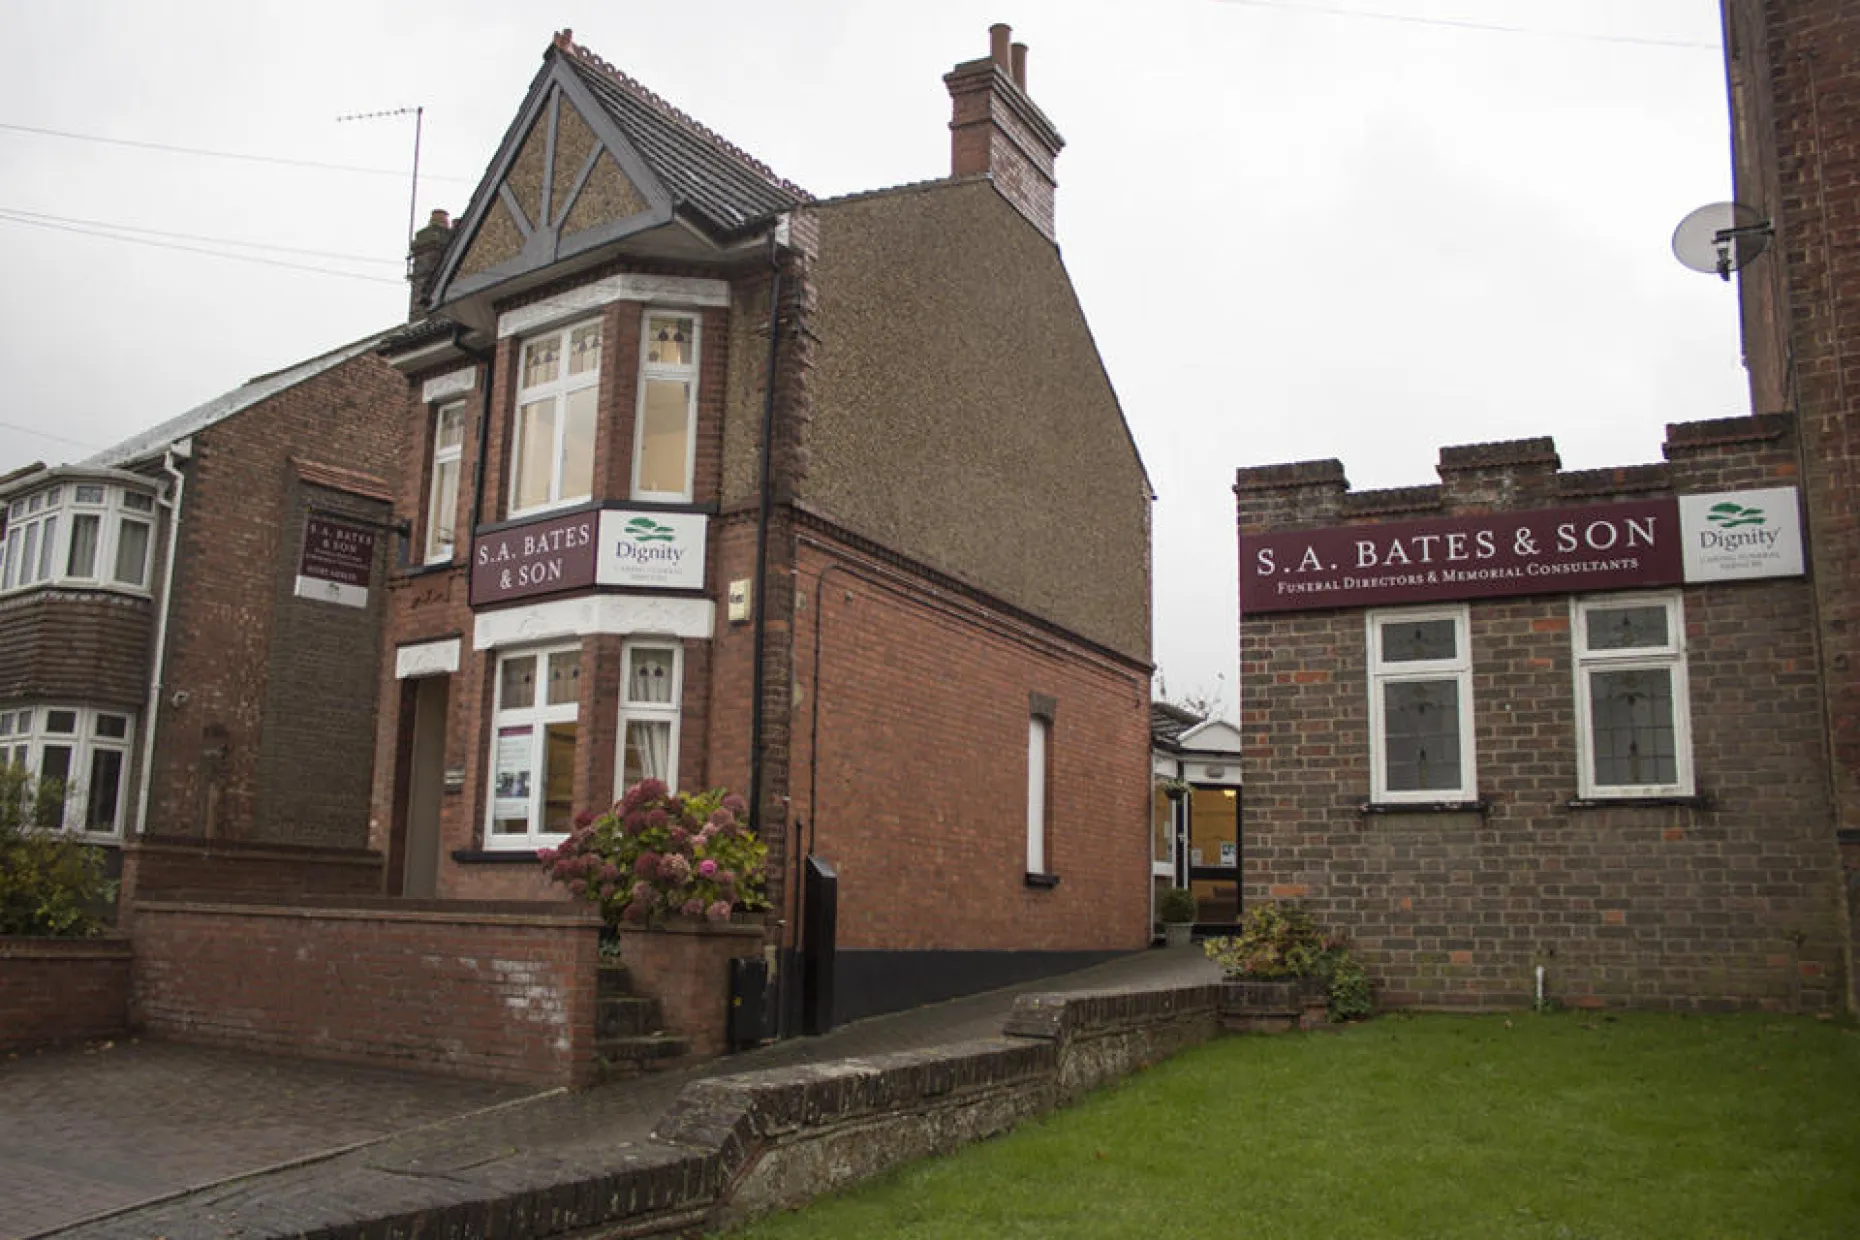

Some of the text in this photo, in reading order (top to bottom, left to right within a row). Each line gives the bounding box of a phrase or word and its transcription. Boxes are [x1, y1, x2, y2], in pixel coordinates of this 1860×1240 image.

[524, 524, 590, 556] BATES
[1355, 529, 1497, 569] BATES
[1513, 526, 1541, 556] &
[1556, 516, 1657, 552] SON
[1699, 526, 1782, 552] Dignity
[615, 541, 684, 567] Dignity
[500, 557, 562, 590] & SON
[1427, 570, 1438, 584] &
